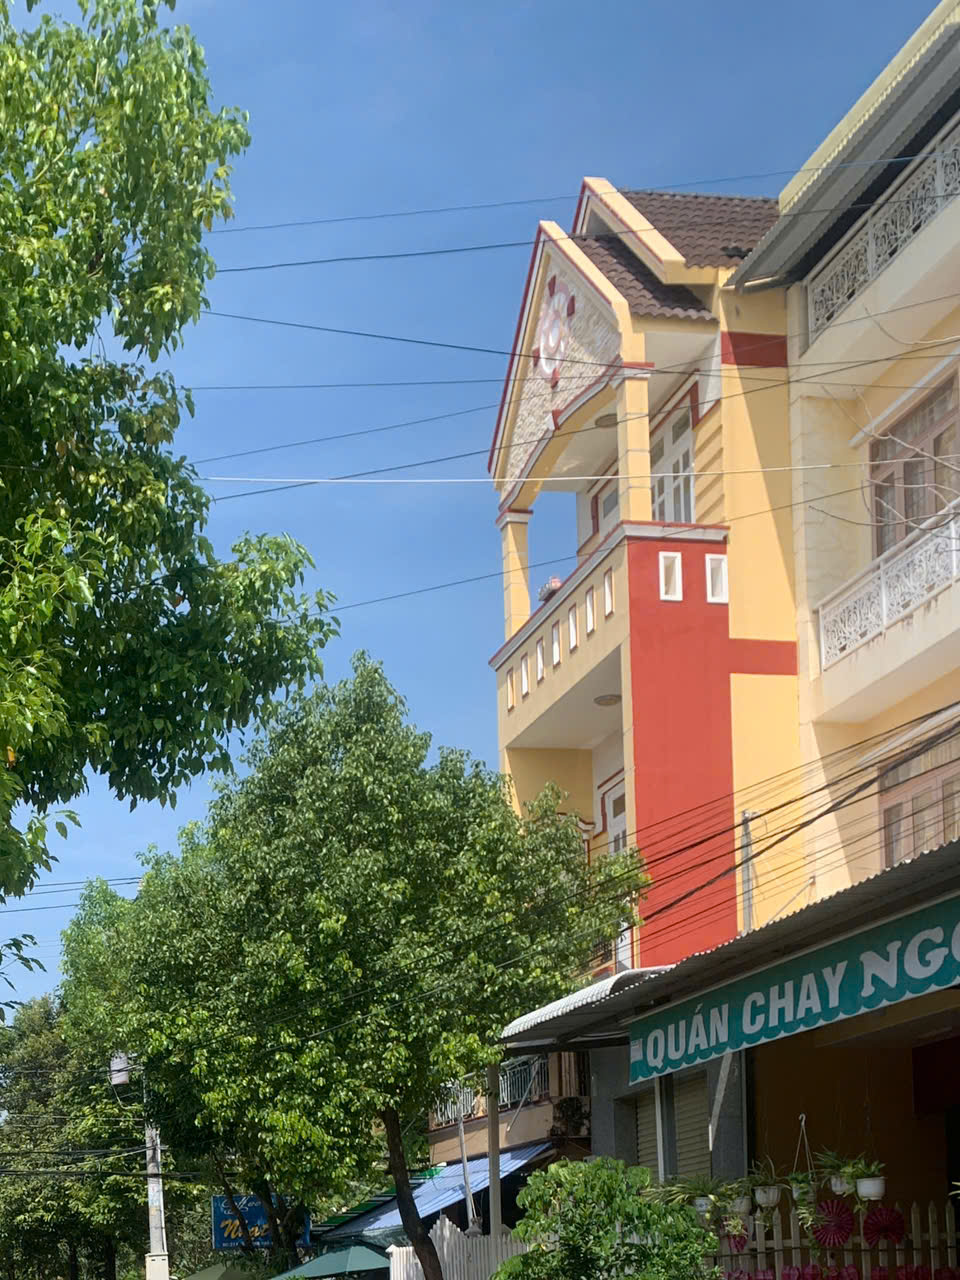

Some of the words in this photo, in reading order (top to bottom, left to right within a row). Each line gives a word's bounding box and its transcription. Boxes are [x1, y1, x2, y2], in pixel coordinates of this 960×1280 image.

[646, 1003, 730, 1069] QUÁN
[742, 960, 848, 1034] CHAY
[859, 920, 960, 998] NG
